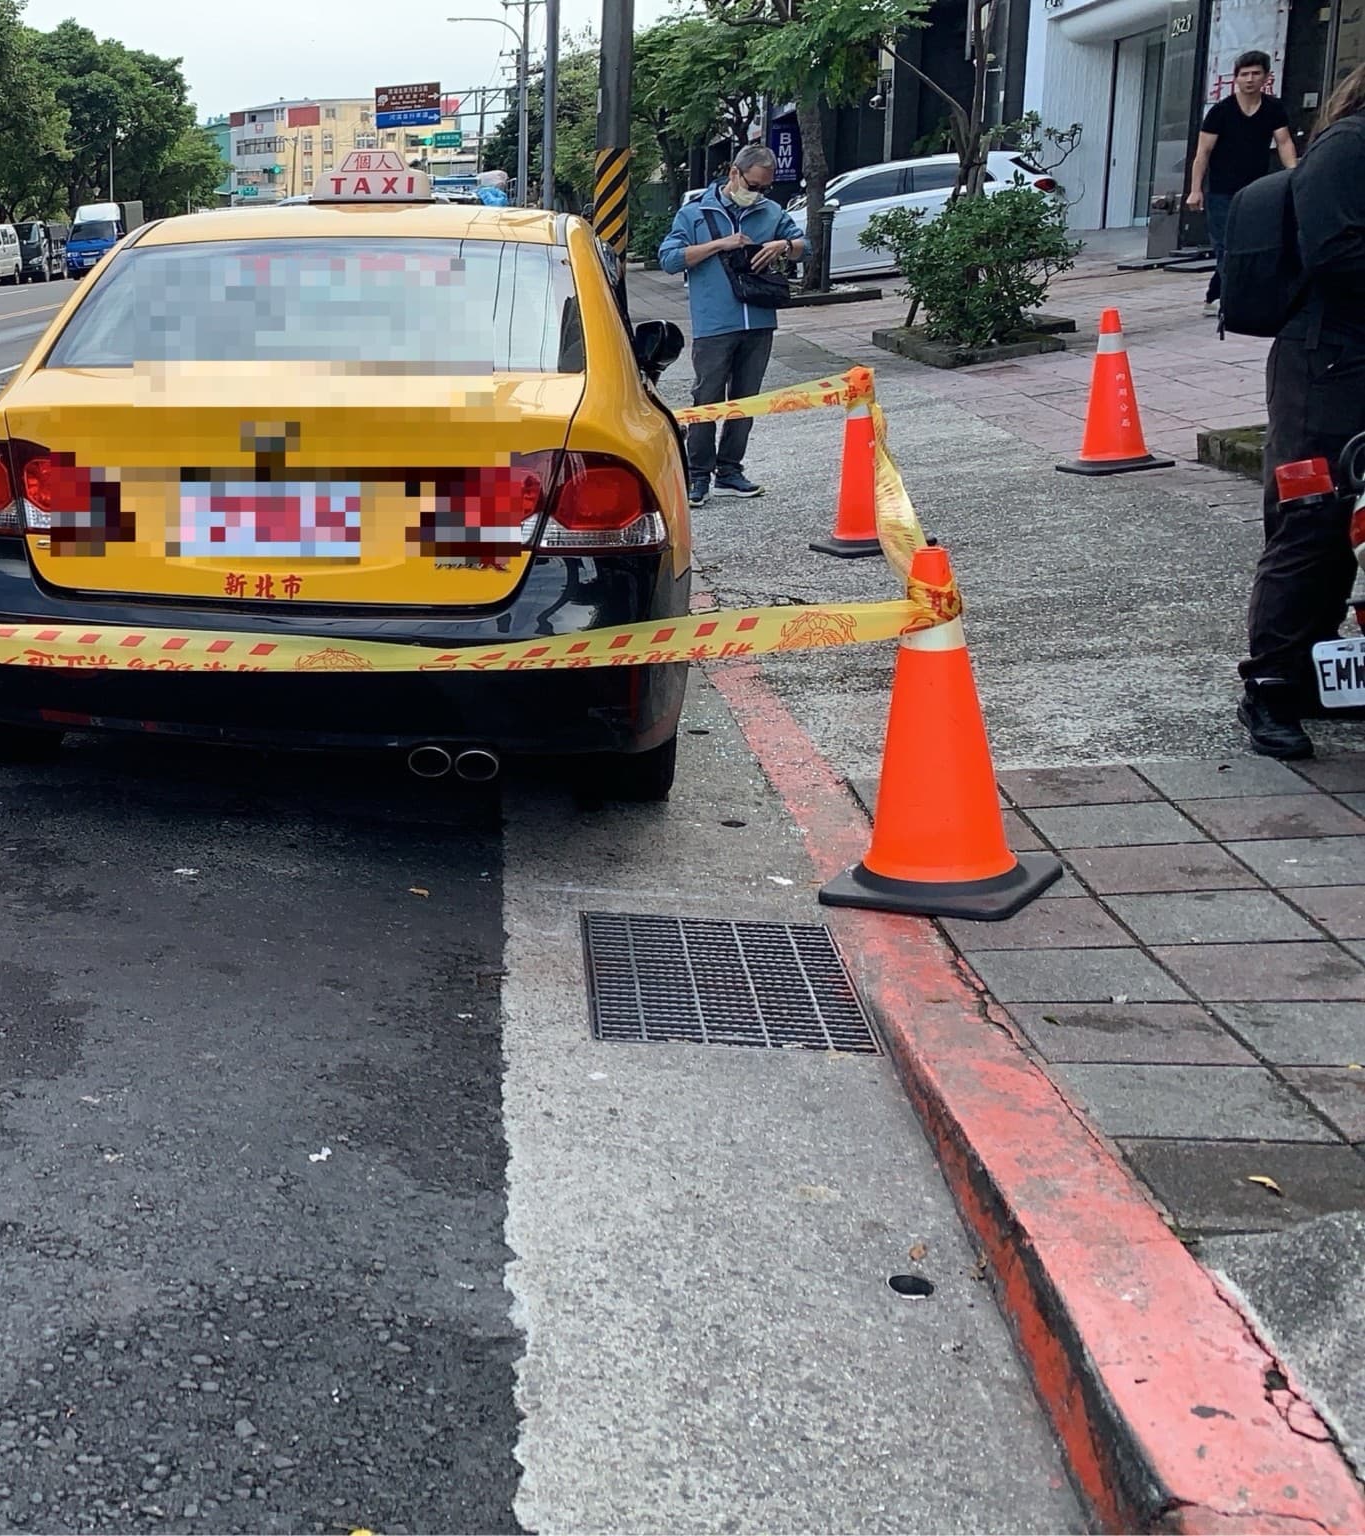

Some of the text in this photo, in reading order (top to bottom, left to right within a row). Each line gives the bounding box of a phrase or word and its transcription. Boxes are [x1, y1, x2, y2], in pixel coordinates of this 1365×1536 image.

[777, 132, 793, 168] BMW
[355, 154, 393, 170] 個人
[330, 176, 415, 195] TAXI
[224, 572, 303, 599] 新北市
